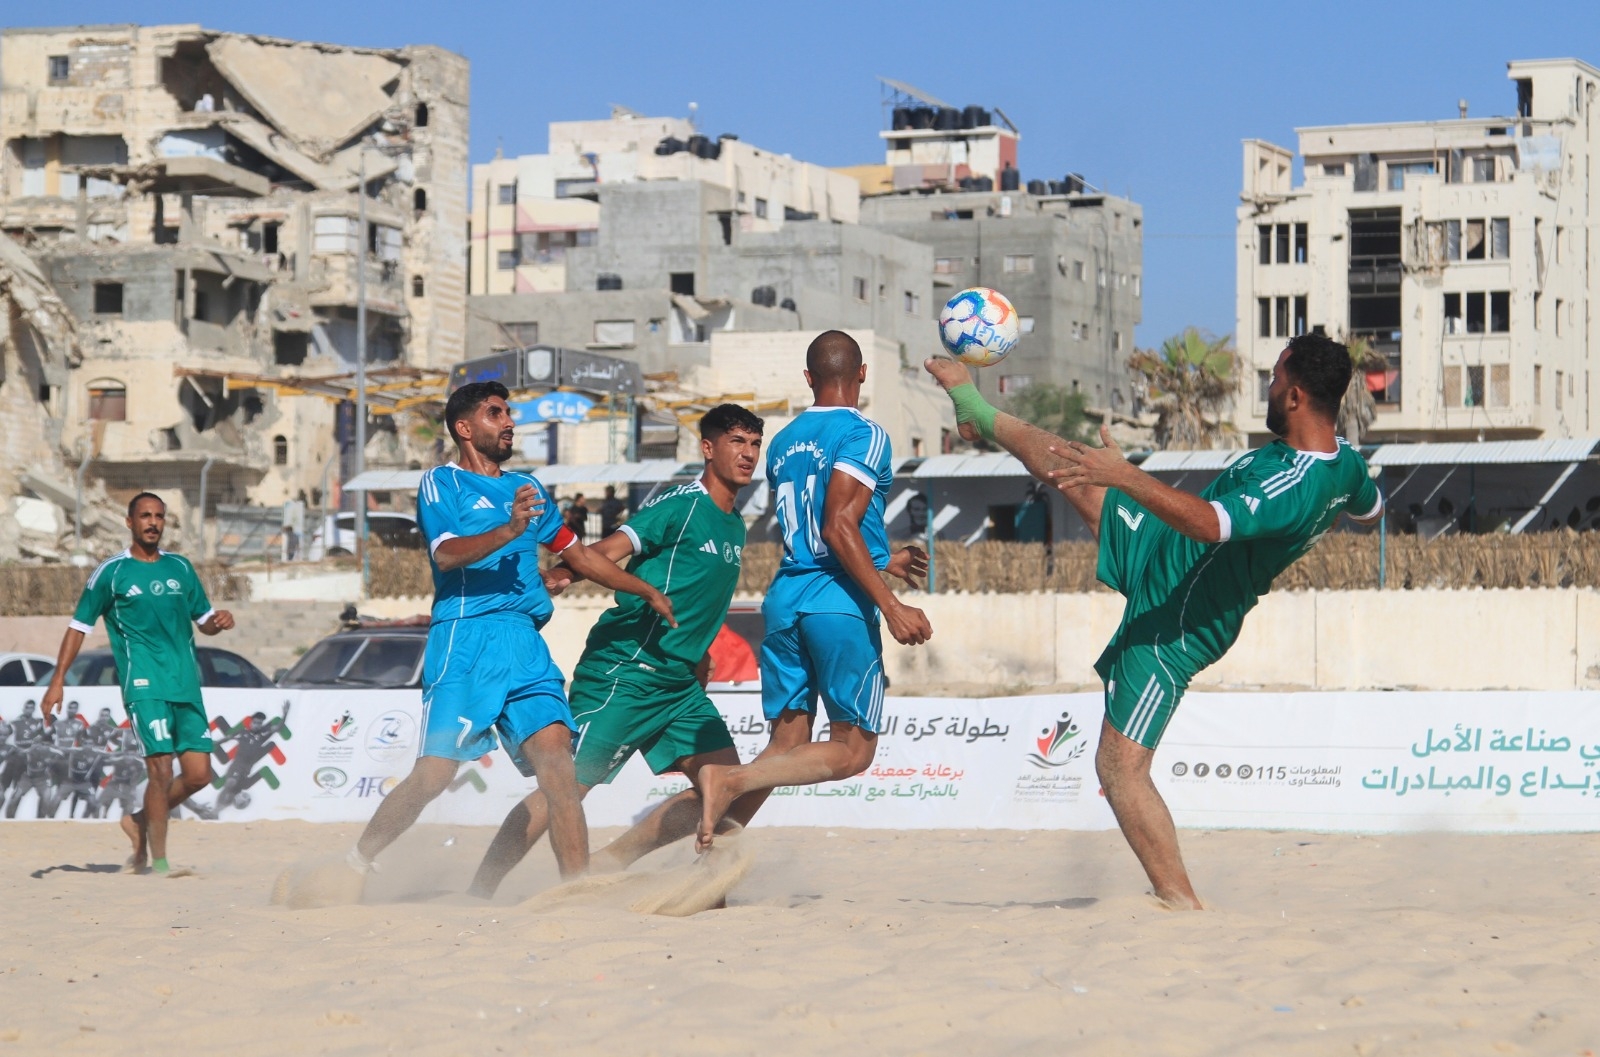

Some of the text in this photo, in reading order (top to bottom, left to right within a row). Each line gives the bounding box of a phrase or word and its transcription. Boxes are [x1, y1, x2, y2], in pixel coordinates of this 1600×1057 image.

[537, 399, 588, 419] Club
[1117, 504, 1145, 532] 7
[456, 716, 473, 748] 7
[904, 716, 943, 743] كرة
[945, 717, 1010, 743] بطولة
[1411, 722, 1600, 767] ي صناعة الأمل
[871, 763, 918, 781] جمعية
[922, 763, 964, 781] برعاية
[1255, 766, 1287, 780] 115
[1290, 765, 1342, 777] المعلومات
[804, 783, 862, 798] الاتحاد
[1288, 776, 1342, 788] والشكاوى
[1361, 766, 1512, 798] والمبادرات
[865, 788, 886, 802] مع
[891, 783, 959, 801] بالشراكة
